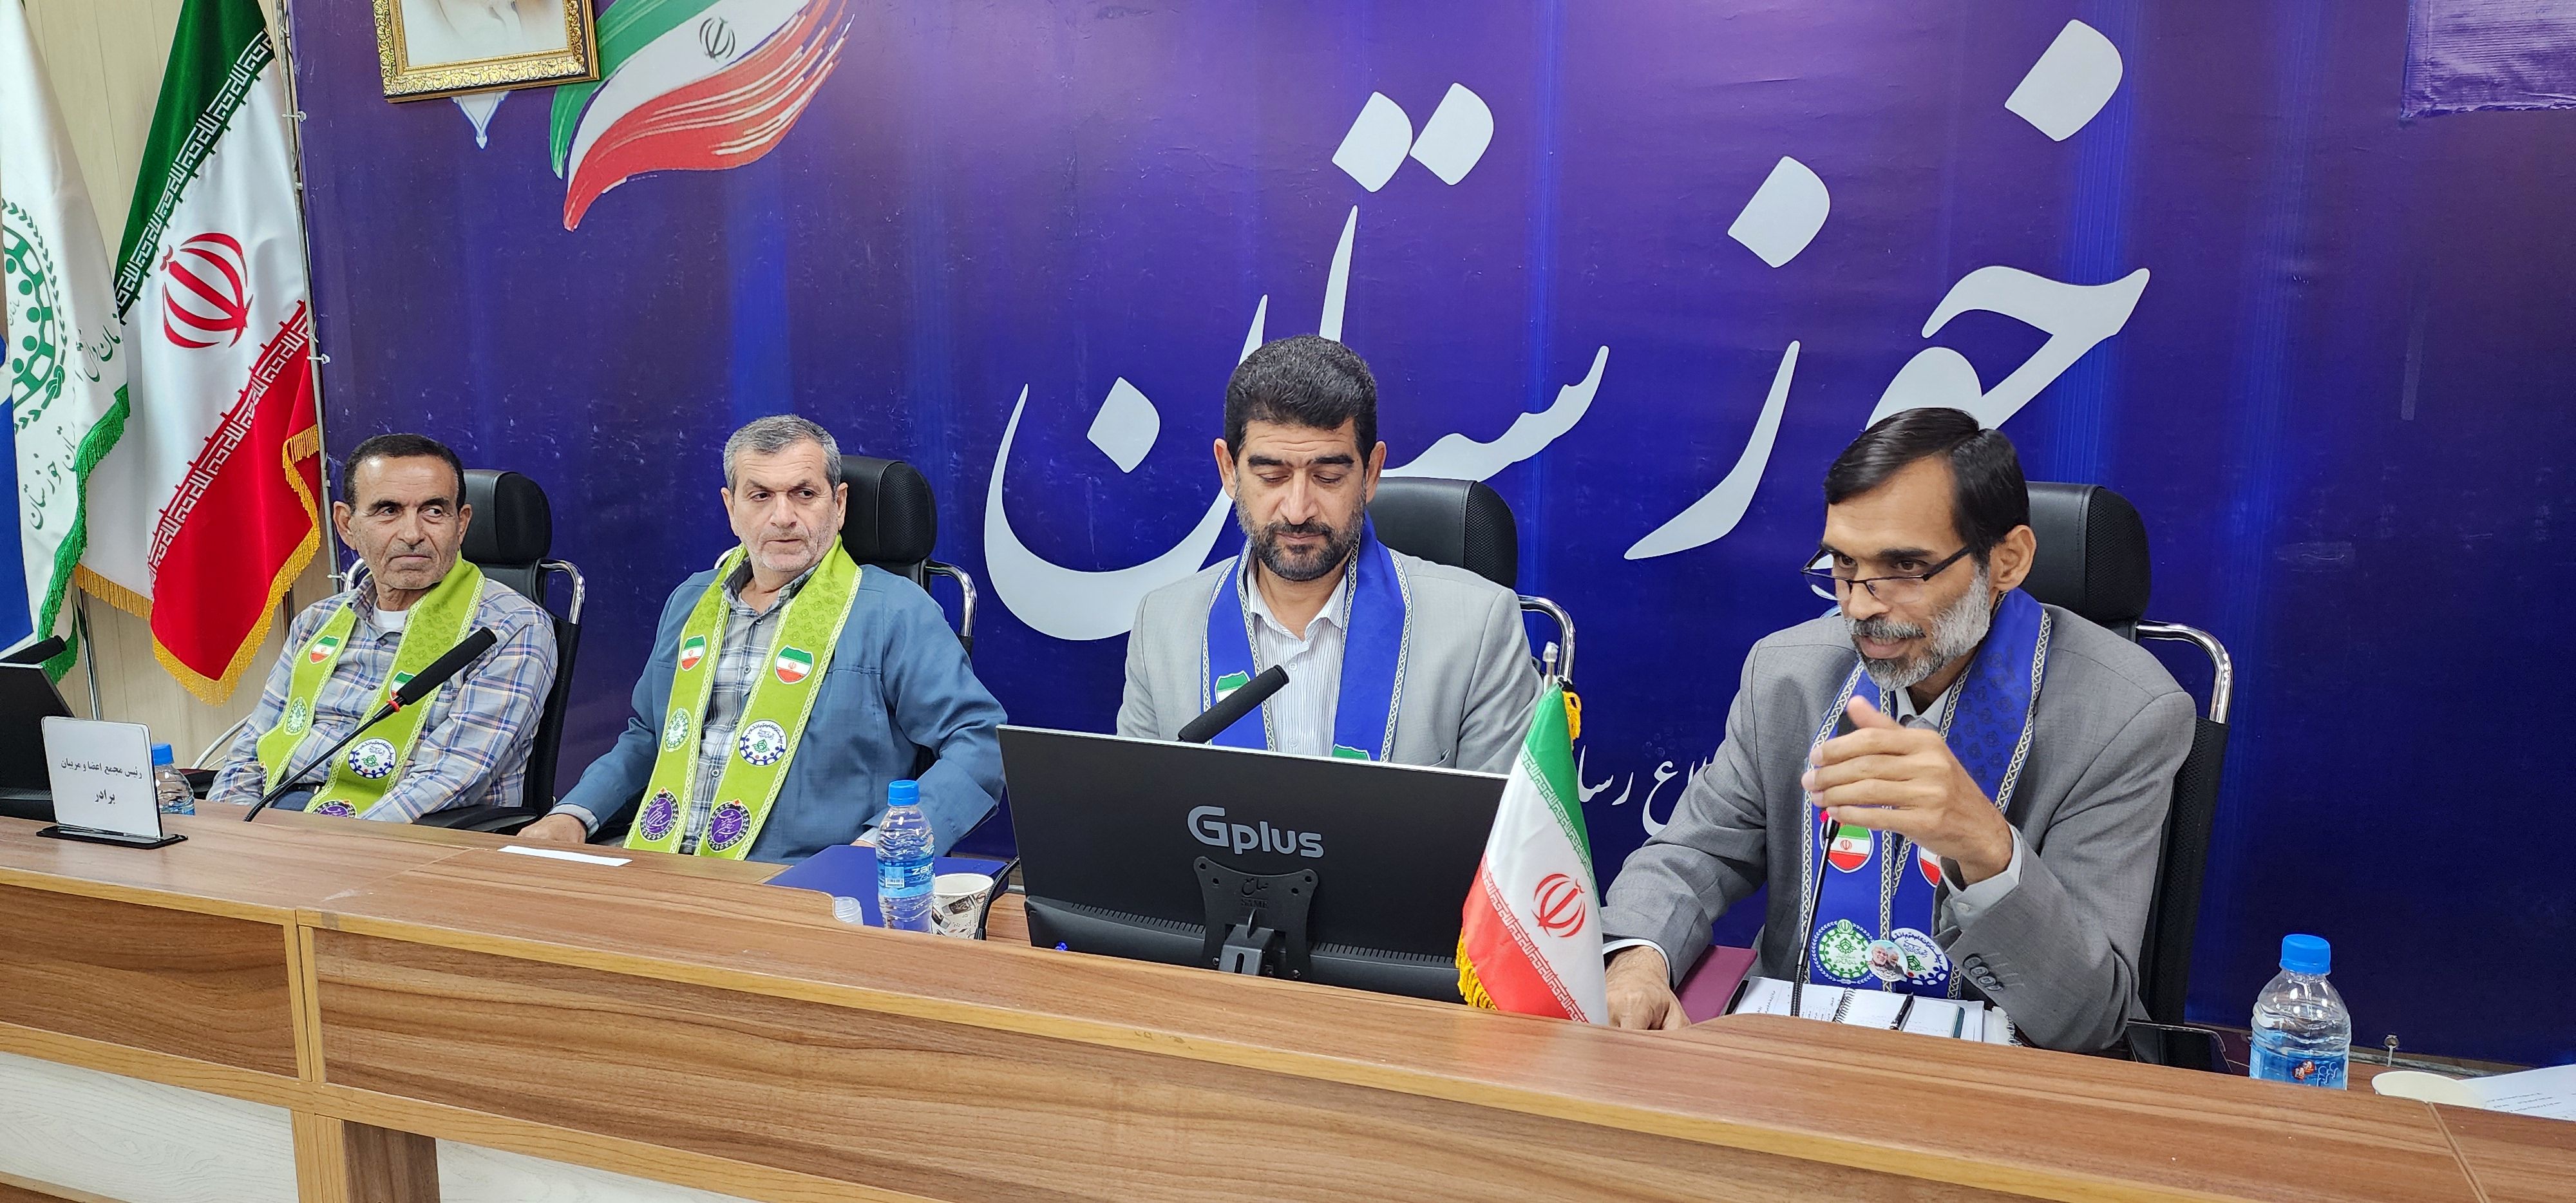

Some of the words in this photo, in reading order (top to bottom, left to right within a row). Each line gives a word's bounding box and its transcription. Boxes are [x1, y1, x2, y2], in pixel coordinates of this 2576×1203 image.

[88, 761, 102, 771] اعضا
[104, 765, 123, 775] مجمع
[1187, 805, 1325, 858] Gplus
